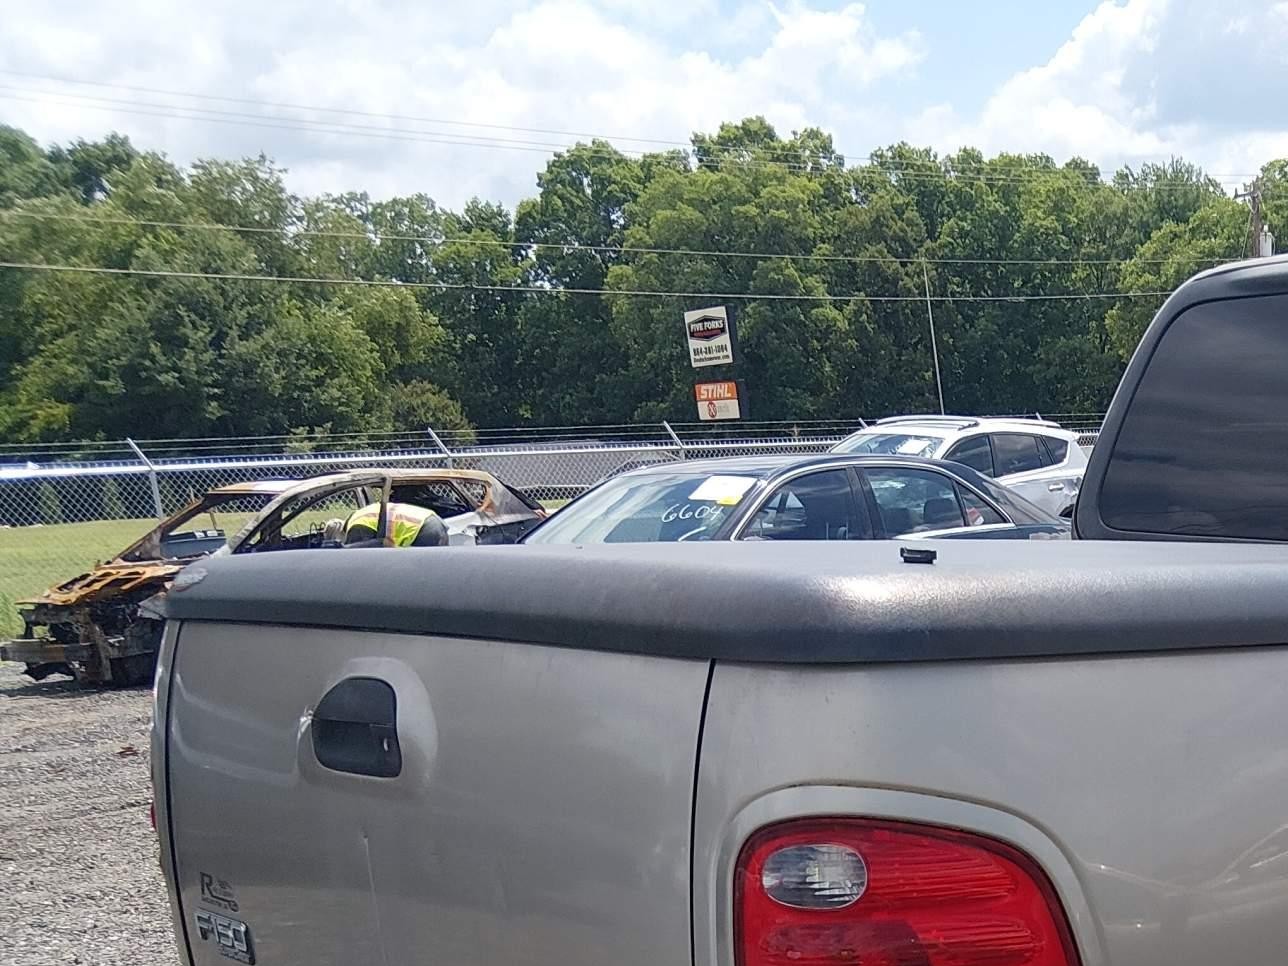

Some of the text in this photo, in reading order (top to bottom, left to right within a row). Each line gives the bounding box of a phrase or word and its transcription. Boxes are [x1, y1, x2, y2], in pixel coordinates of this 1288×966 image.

[690, 319, 724, 332] FIVE FORKS
[700, 382, 732, 399] STIHL
[661, 503, 725, 523] 6604
